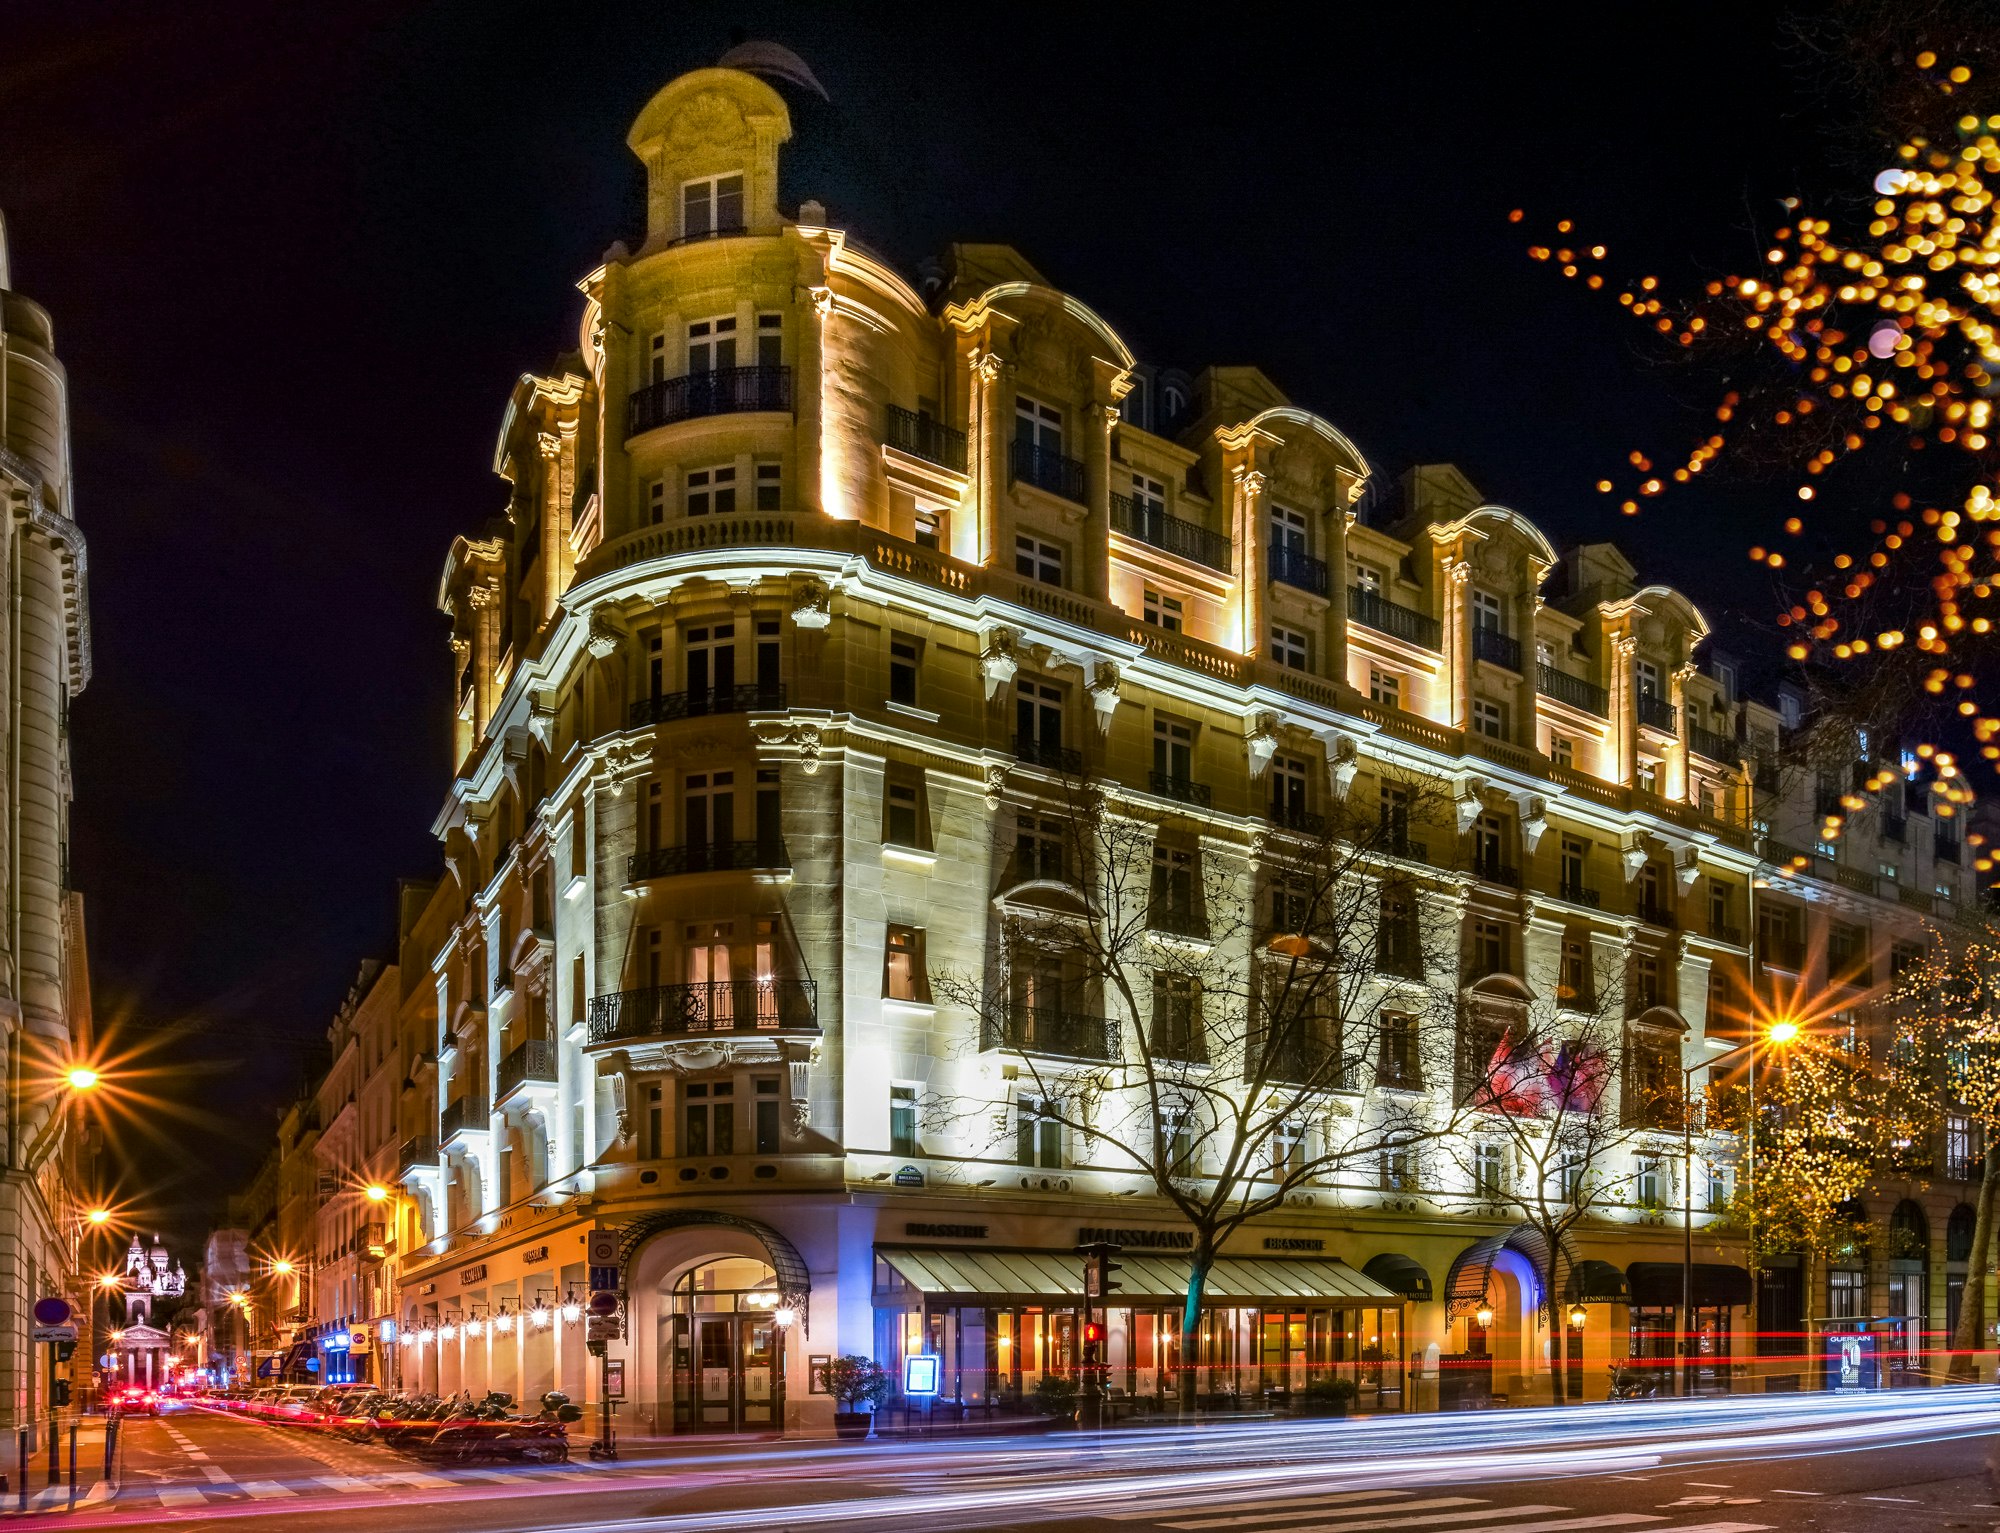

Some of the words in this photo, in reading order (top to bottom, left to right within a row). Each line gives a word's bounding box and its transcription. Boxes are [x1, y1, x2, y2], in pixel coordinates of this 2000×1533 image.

[906, 1223, 989, 1239] BRASSERIE
[1079, 1228, 1194, 1249] HAUSSMANN
[1264, 1237, 1327, 1251] BRASSERIE
[1830, 1335, 1871, 1343] GUERLAIN
